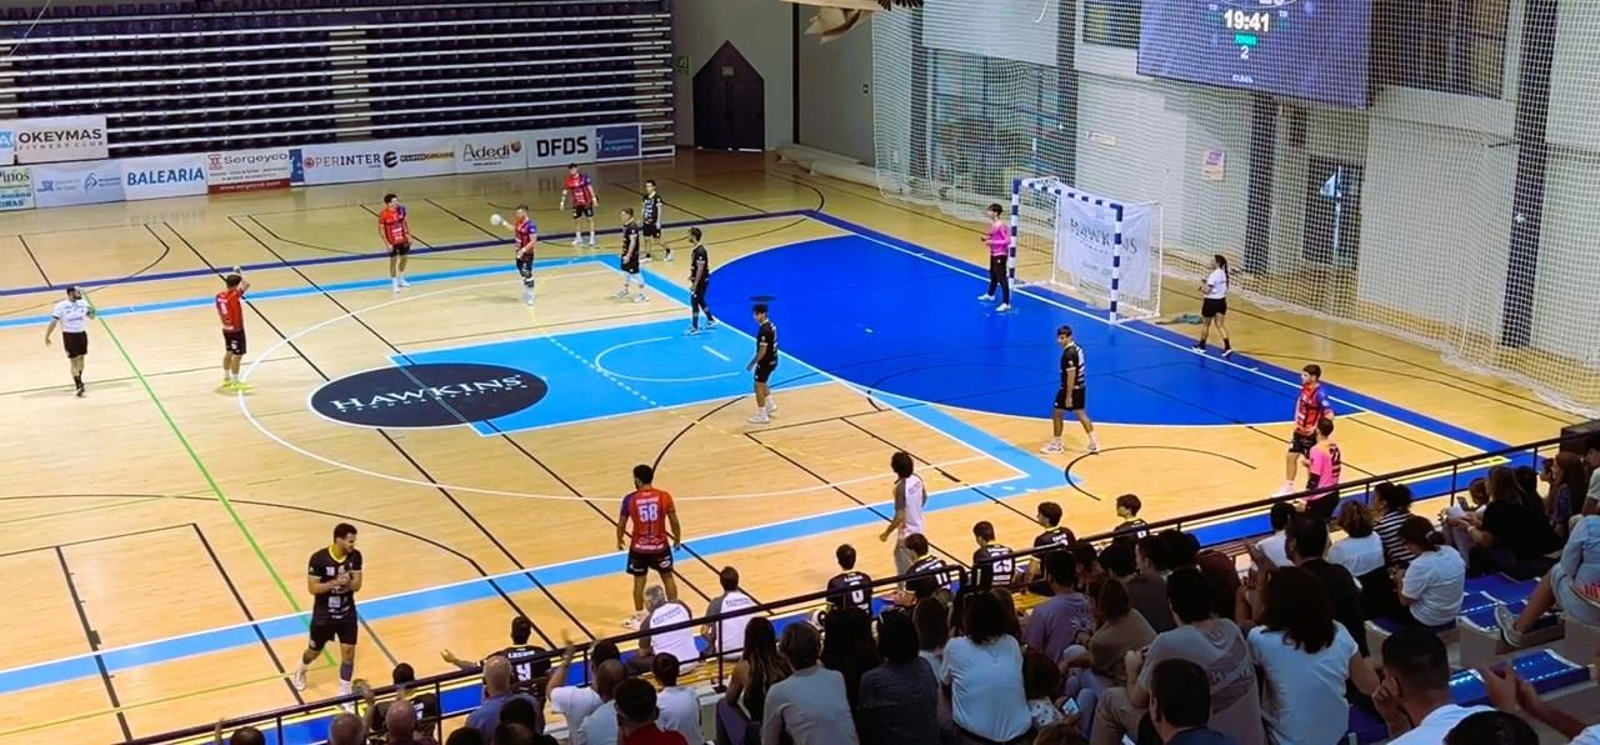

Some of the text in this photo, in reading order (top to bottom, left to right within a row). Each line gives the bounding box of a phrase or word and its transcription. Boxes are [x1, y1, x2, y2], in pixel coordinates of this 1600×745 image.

[1224, 9, 1270, 32] 19:41
[1240, 45, 1250, 59] 2
[18, 129, 103, 143] OKEYMAS
[463, 143, 510, 161] Adedi
[536, 136, 589, 157] DFDS
[1070, 218, 1138, 254] HAWKNS
[330, 375, 522, 410] HAWKINS
[637, 503, 659, 523] 58
